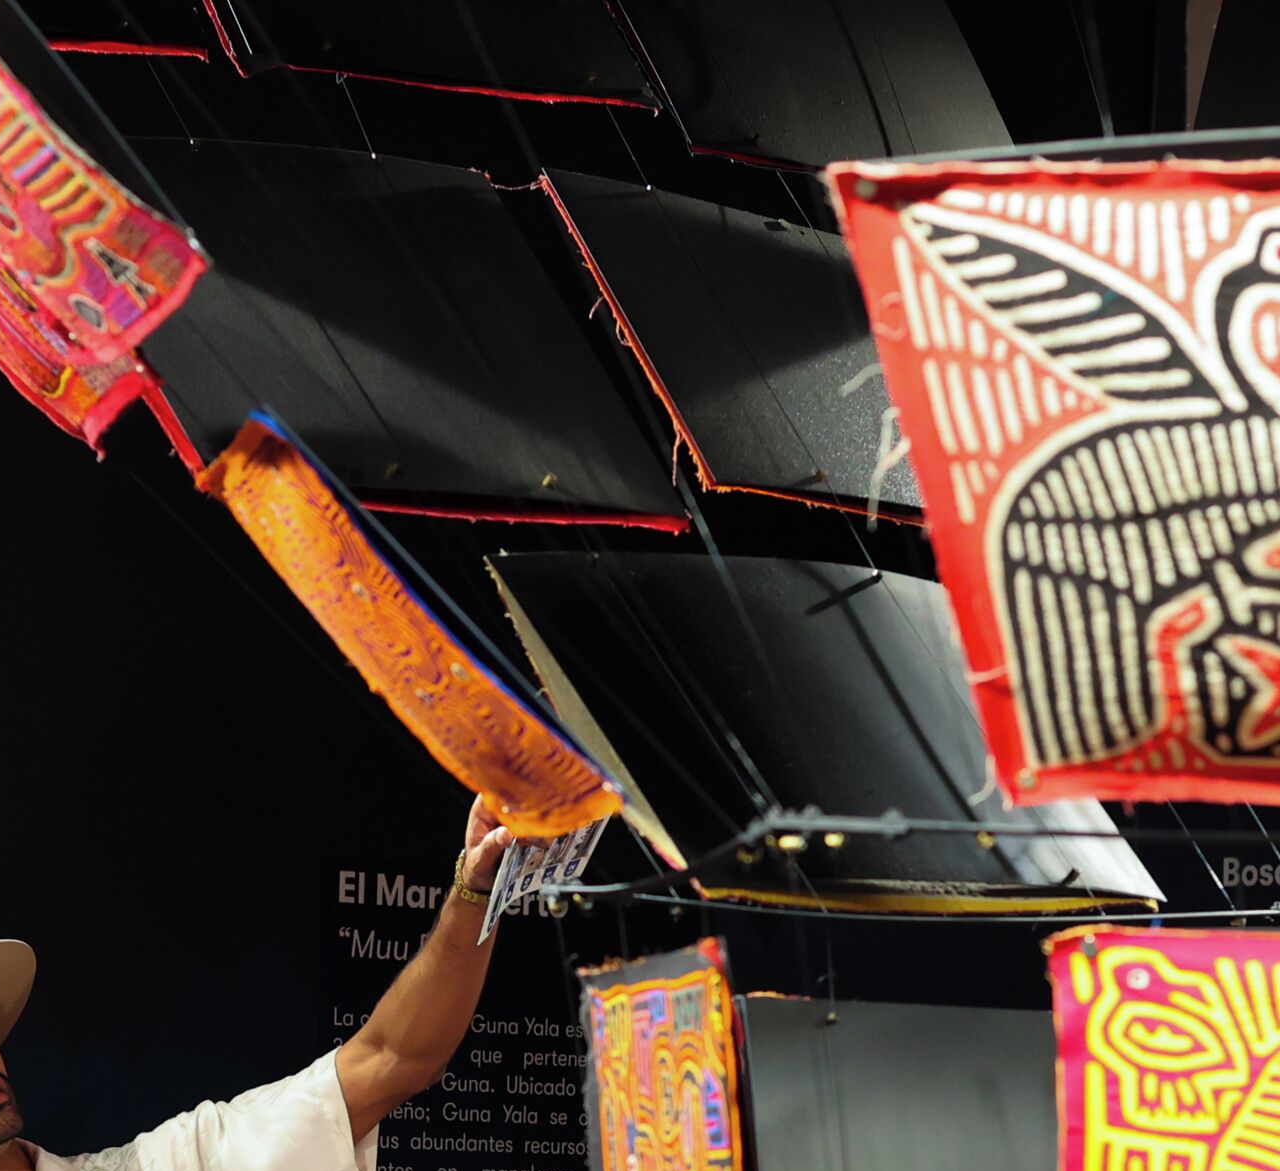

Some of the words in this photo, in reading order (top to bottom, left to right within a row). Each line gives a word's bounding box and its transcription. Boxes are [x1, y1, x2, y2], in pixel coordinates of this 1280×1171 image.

[337, 869, 366, 905] El
[375, 872, 442, 911] Mar
[504, 889, 569, 919] erto
[337, 925, 410, 961] “Muu
[333, 1006, 354, 1028] La
[470, 1013, 519, 1035] Guna
[524, 1016, 560, 1038] Yala
[470, 1048, 503, 1067] que
[523, 1047, 587, 1070] pertene
[441, 1072, 495, 1094] Guna.
[506, 1075, 577, 1097] Ubicado
[387, 1101, 431, 1124] eño;
[442, 1102, 492, 1123] Guna
[502, 1104, 539, 1125] Yala
[549, 1111, 568, 1126] se
[377, 1134, 400, 1150] us
[410, 1131, 514, 1153] abundantes
